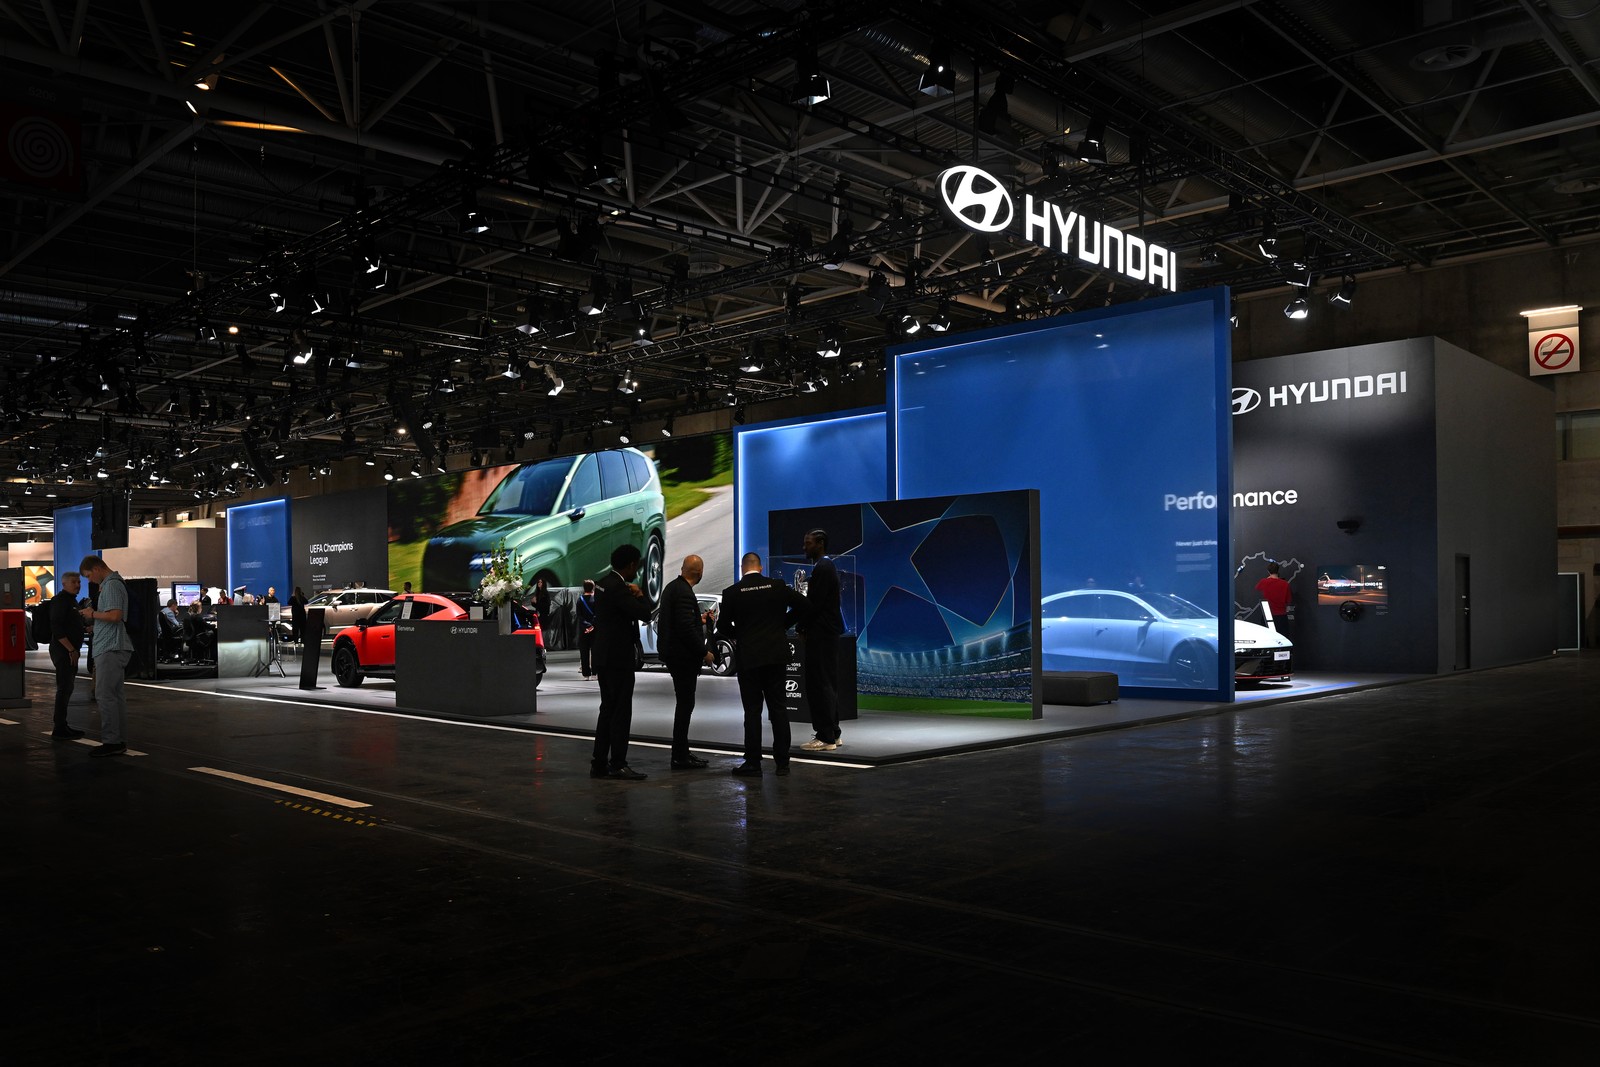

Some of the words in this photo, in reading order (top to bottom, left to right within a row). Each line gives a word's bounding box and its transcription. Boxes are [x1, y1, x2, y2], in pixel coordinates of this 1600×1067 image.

[1026, 194, 1176, 292] HYUNDAI
[1269, 371, 1407, 407] HYUNDAI
[309, 544, 323, 554] UEFA
[323, 541, 354, 553] Champions
[309, 556, 329, 566] League
